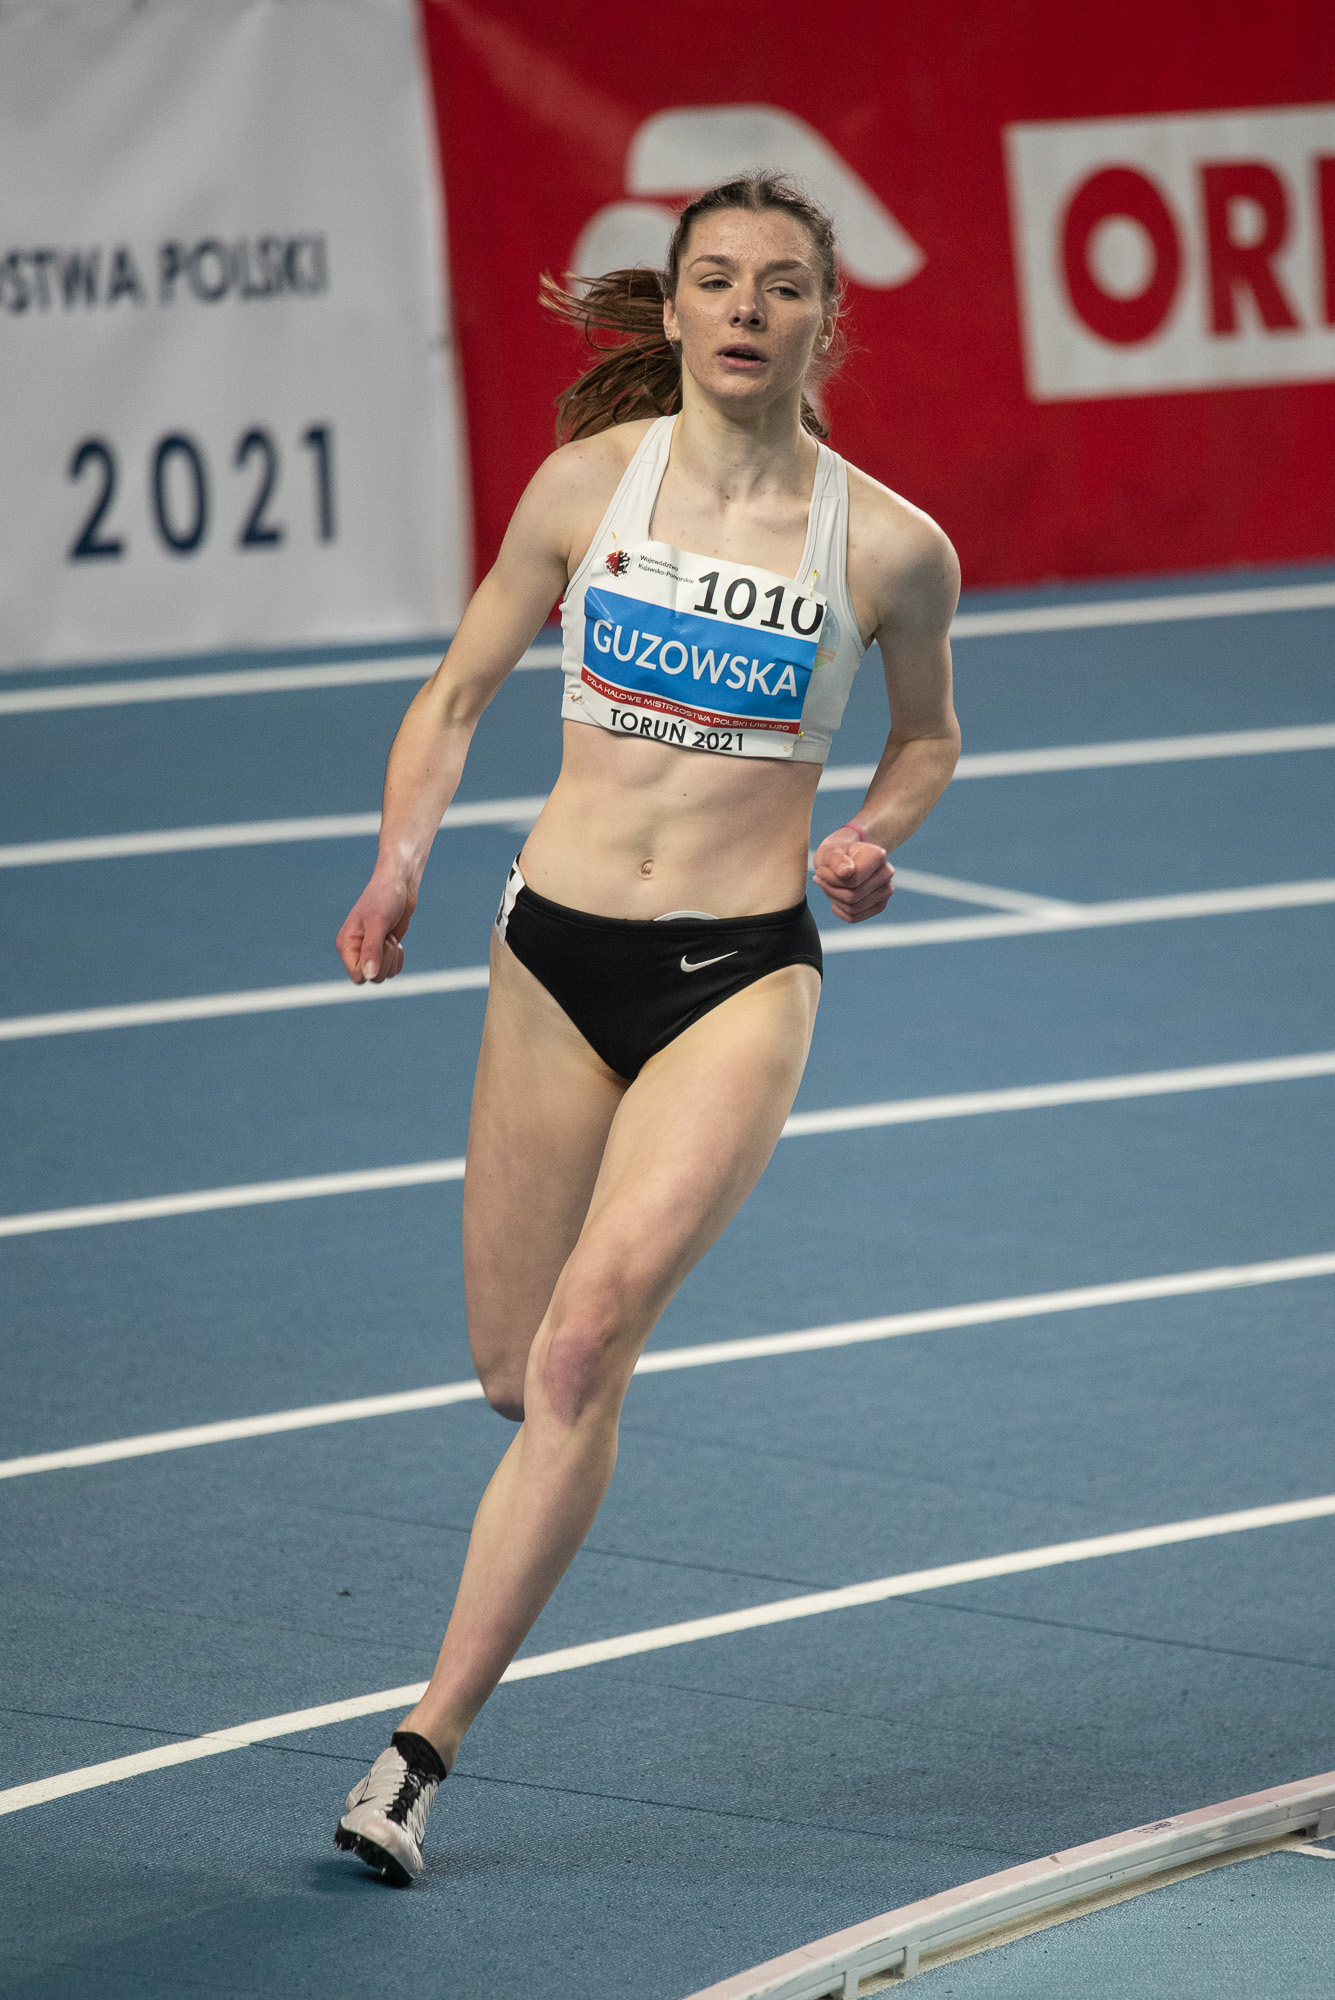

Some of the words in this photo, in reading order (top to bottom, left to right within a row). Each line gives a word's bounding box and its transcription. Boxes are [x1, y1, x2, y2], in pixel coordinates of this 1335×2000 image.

[157, 232, 329, 307] POLSKI
[68, 422, 336, 565] 2021
[693, 571, 825, 636] 1010
[593, 619, 798, 698] GUZOWSKA
[587, 675, 604, 692] PZLA
[604, 687, 642, 704] HALOWE
[643, 698, 711, 724] MISTRZOSTWA
[713, 717, 748, 728] POLSKI
[769, 723, 790, 731] U20
[610, 707, 687, 744] TORUŃ
[692, 731, 743, 751] 2021
